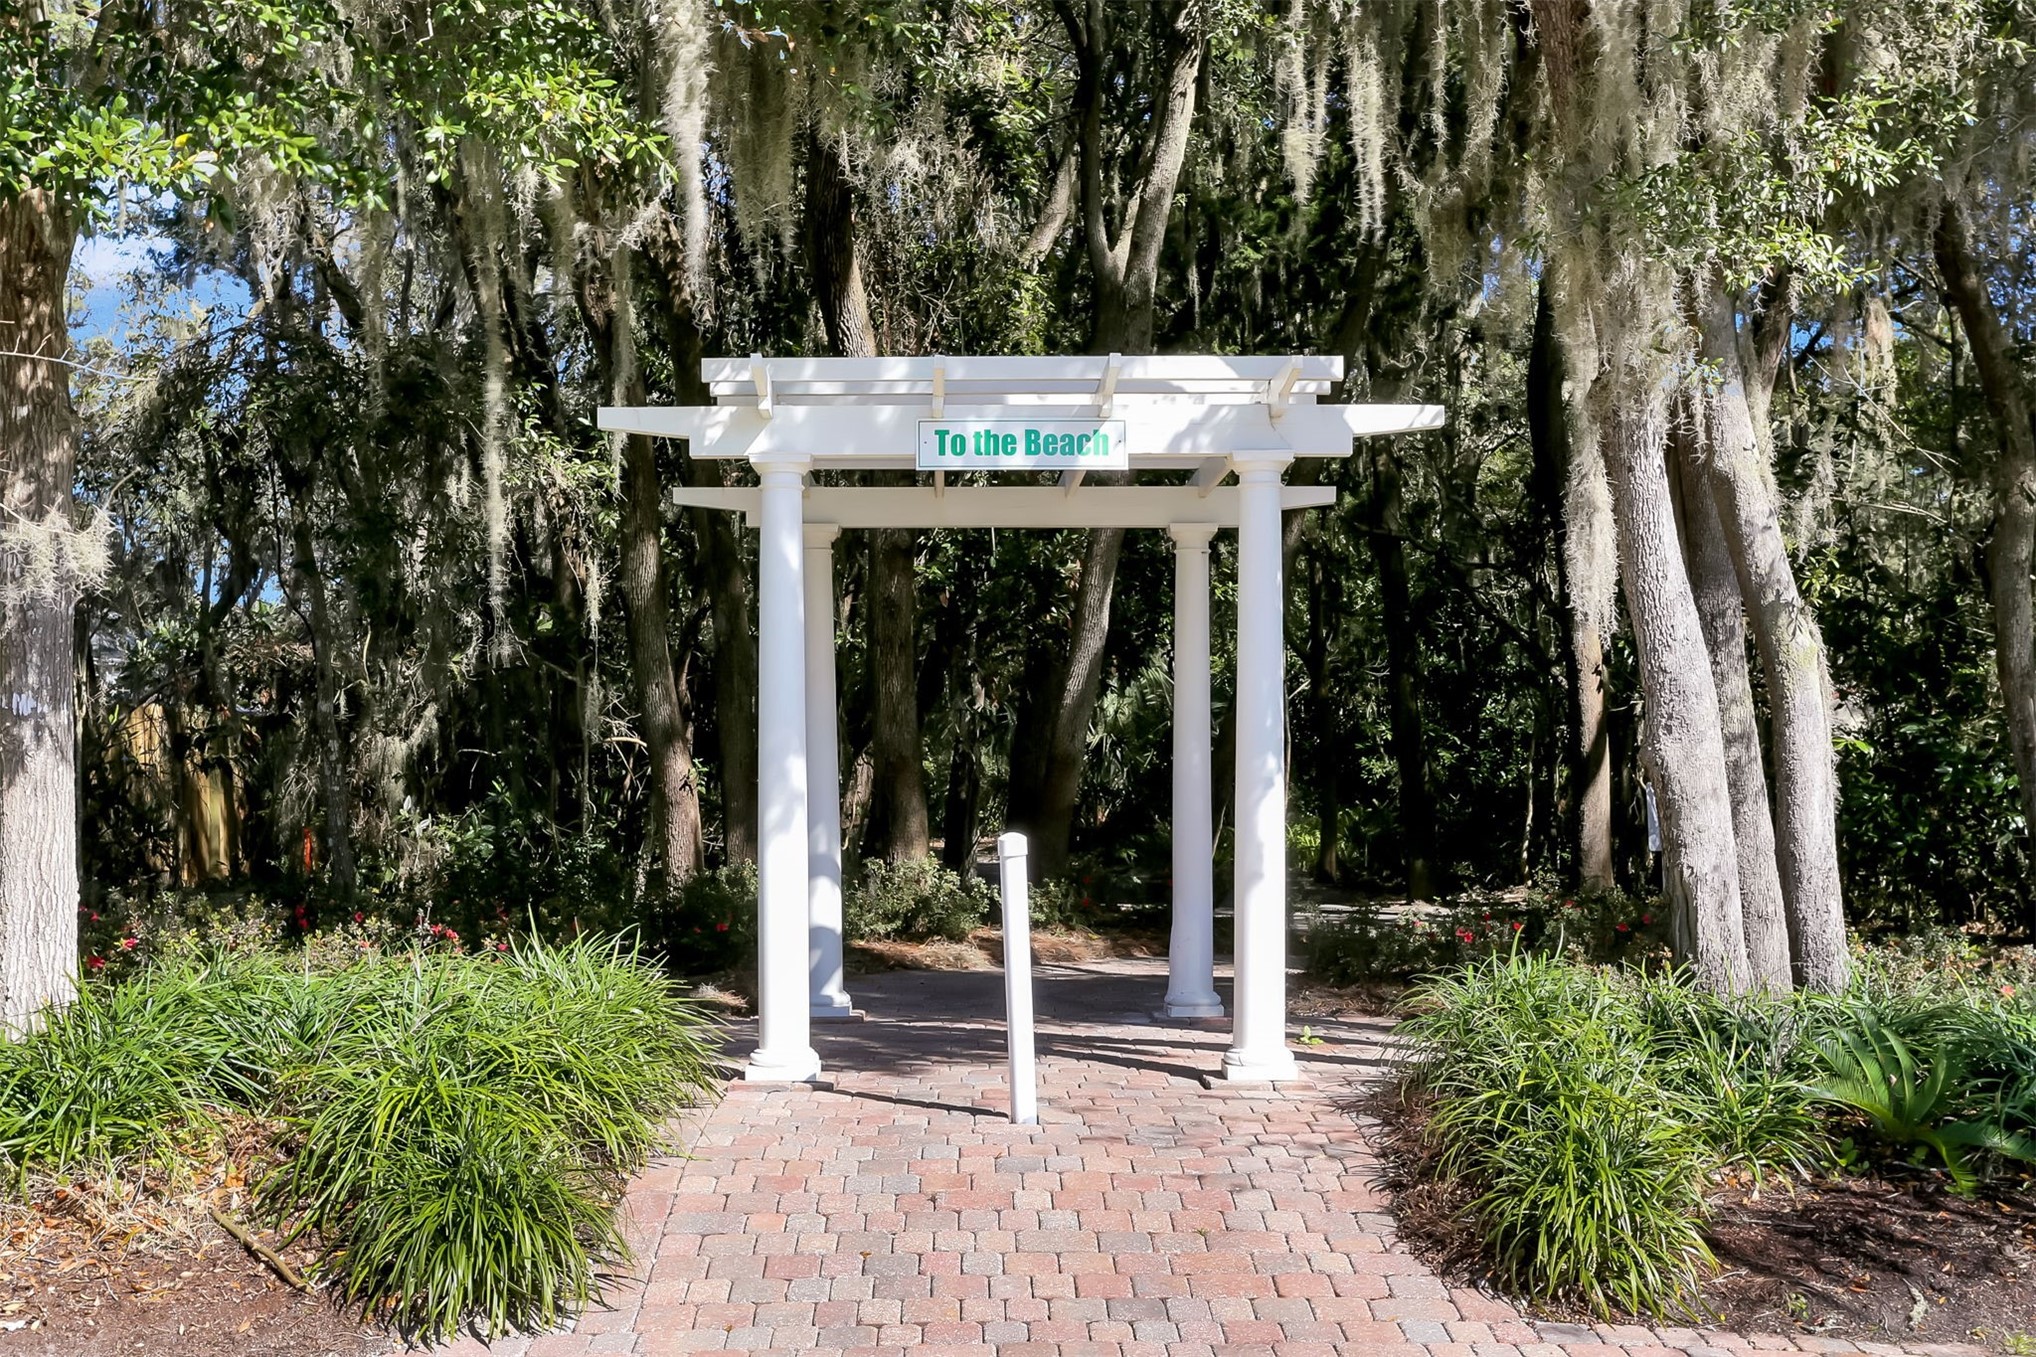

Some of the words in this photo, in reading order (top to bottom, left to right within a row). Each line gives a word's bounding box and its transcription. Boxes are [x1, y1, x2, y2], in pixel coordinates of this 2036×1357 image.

[934, 429, 967, 456] To
[973, 429, 1018, 456] the
[1024, 428, 1109, 456] Beach
